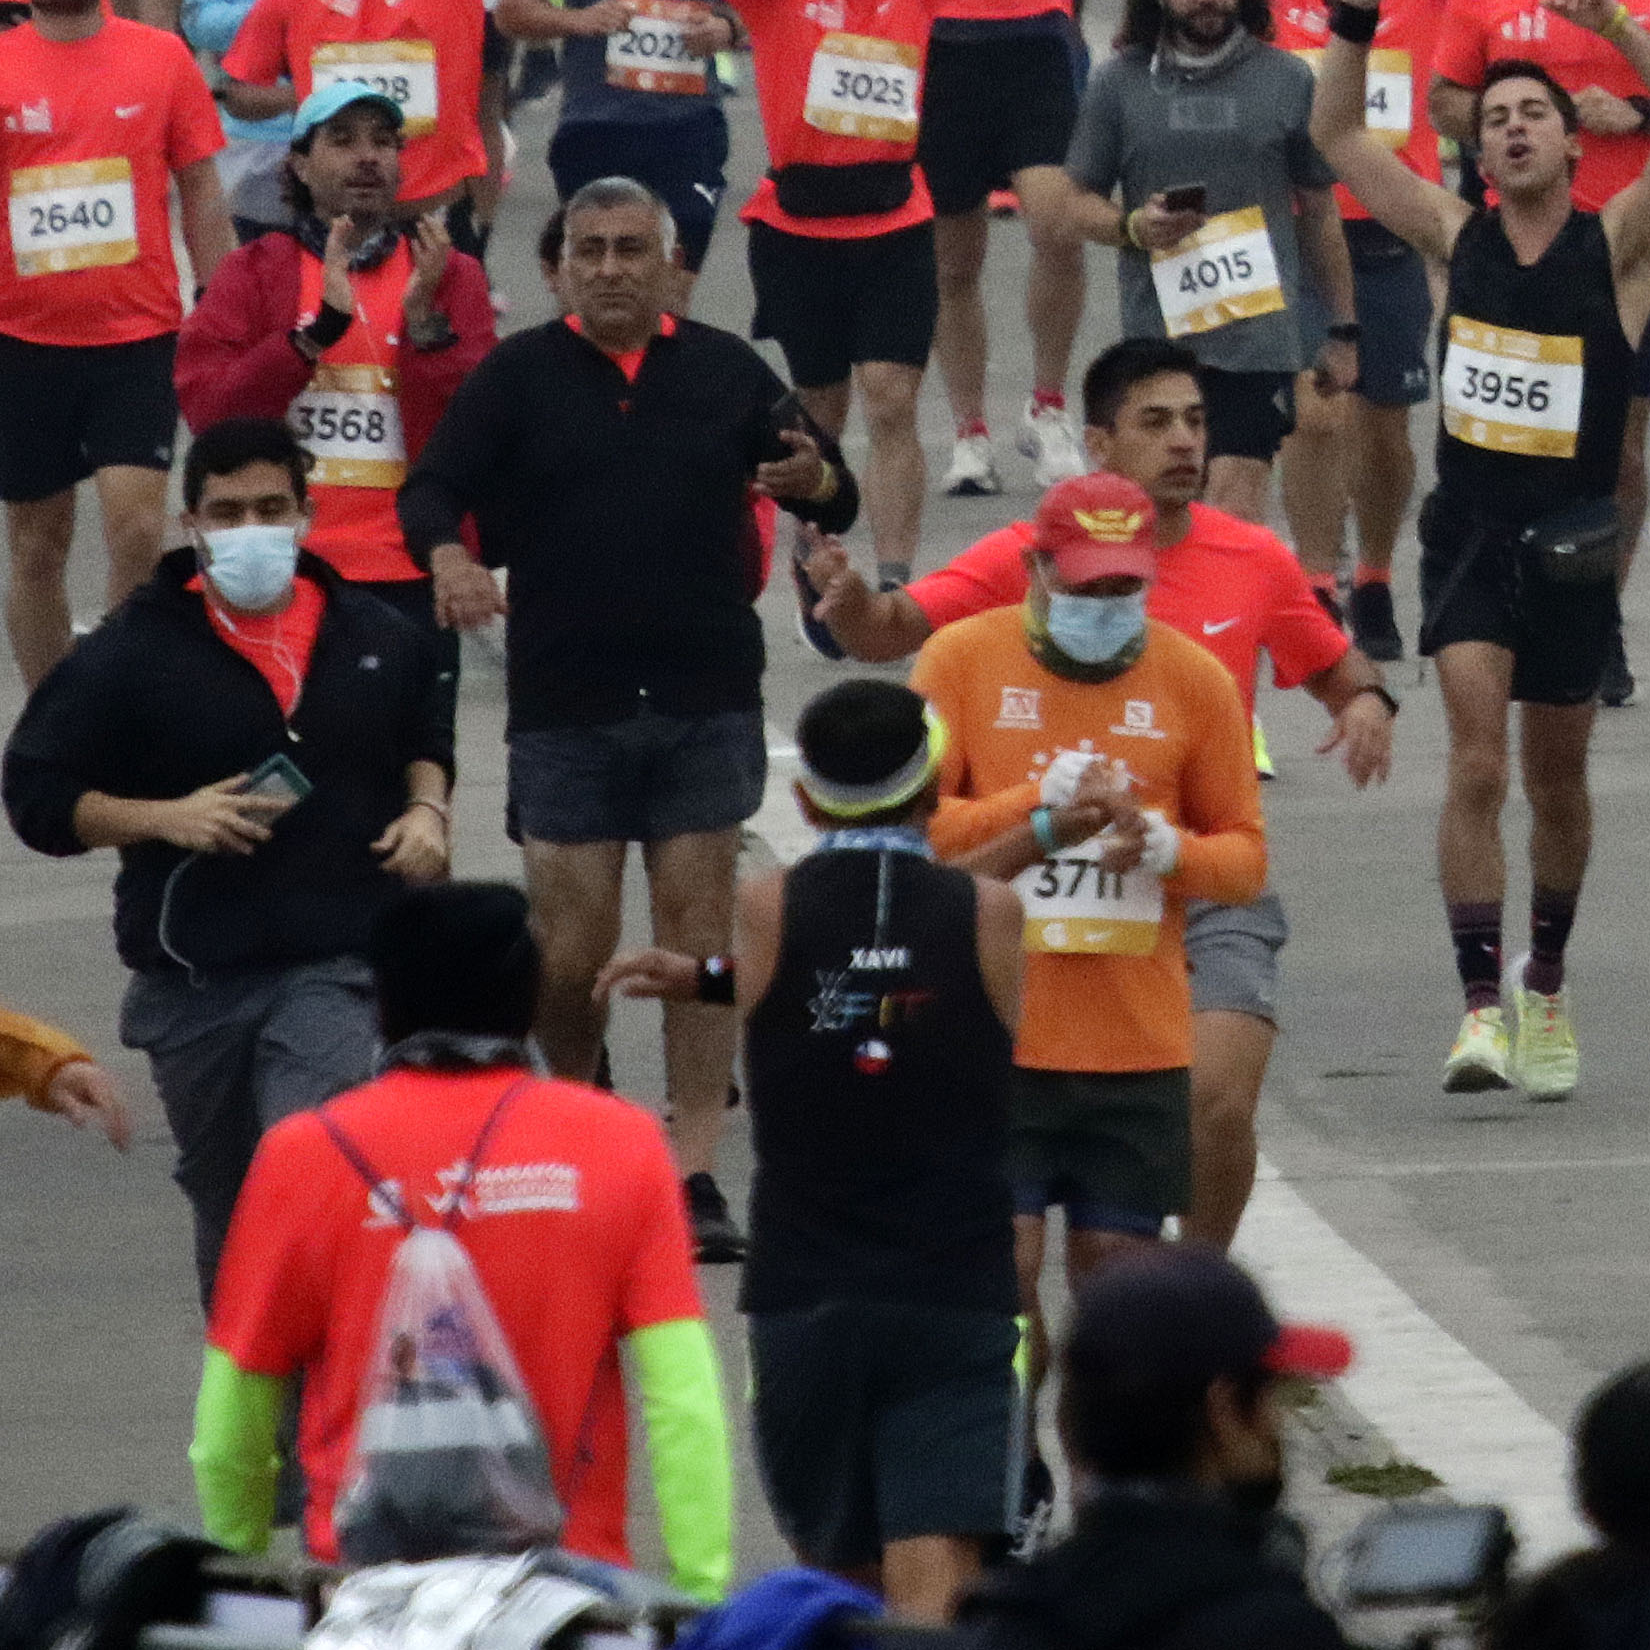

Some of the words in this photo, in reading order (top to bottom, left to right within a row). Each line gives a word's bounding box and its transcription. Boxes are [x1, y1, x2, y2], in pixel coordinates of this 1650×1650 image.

[831, 67, 906, 108] 3025
[28, 198, 114, 238] 2640
[1179, 248, 1253, 297] 4015
[1460, 366, 1551, 414] 3956
[300, 406, 386, 444] 3568
